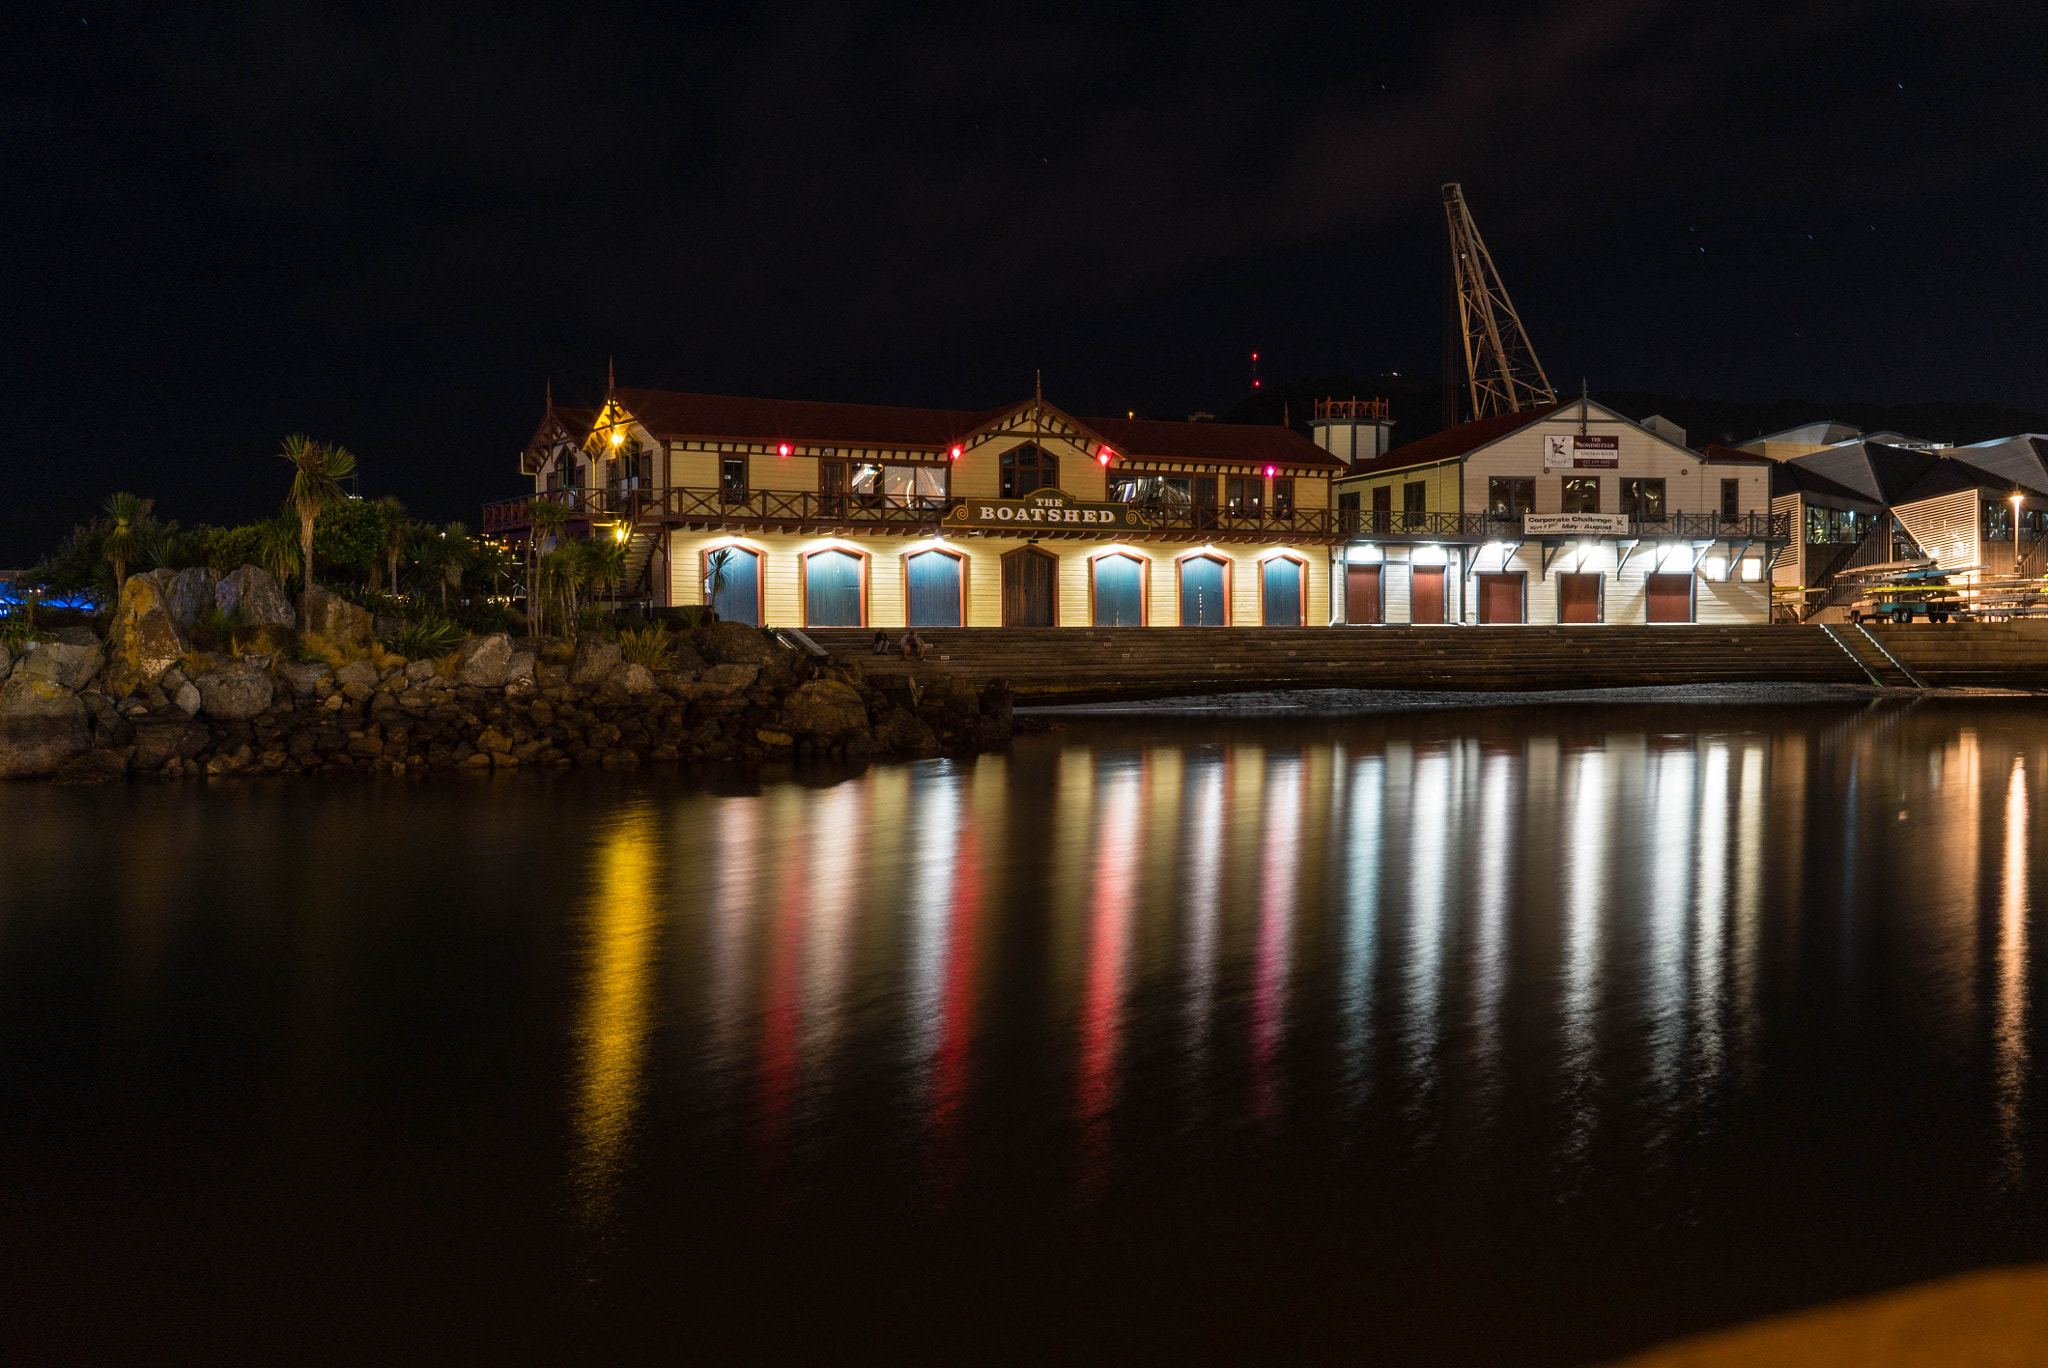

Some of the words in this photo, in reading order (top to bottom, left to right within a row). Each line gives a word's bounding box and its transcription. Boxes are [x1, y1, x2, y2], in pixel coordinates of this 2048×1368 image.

[1036, 498, 1063, 507] THE
[980, 507, 1115, 523] BOATSHED
[1571, 516, 1613, 524] Challenge
